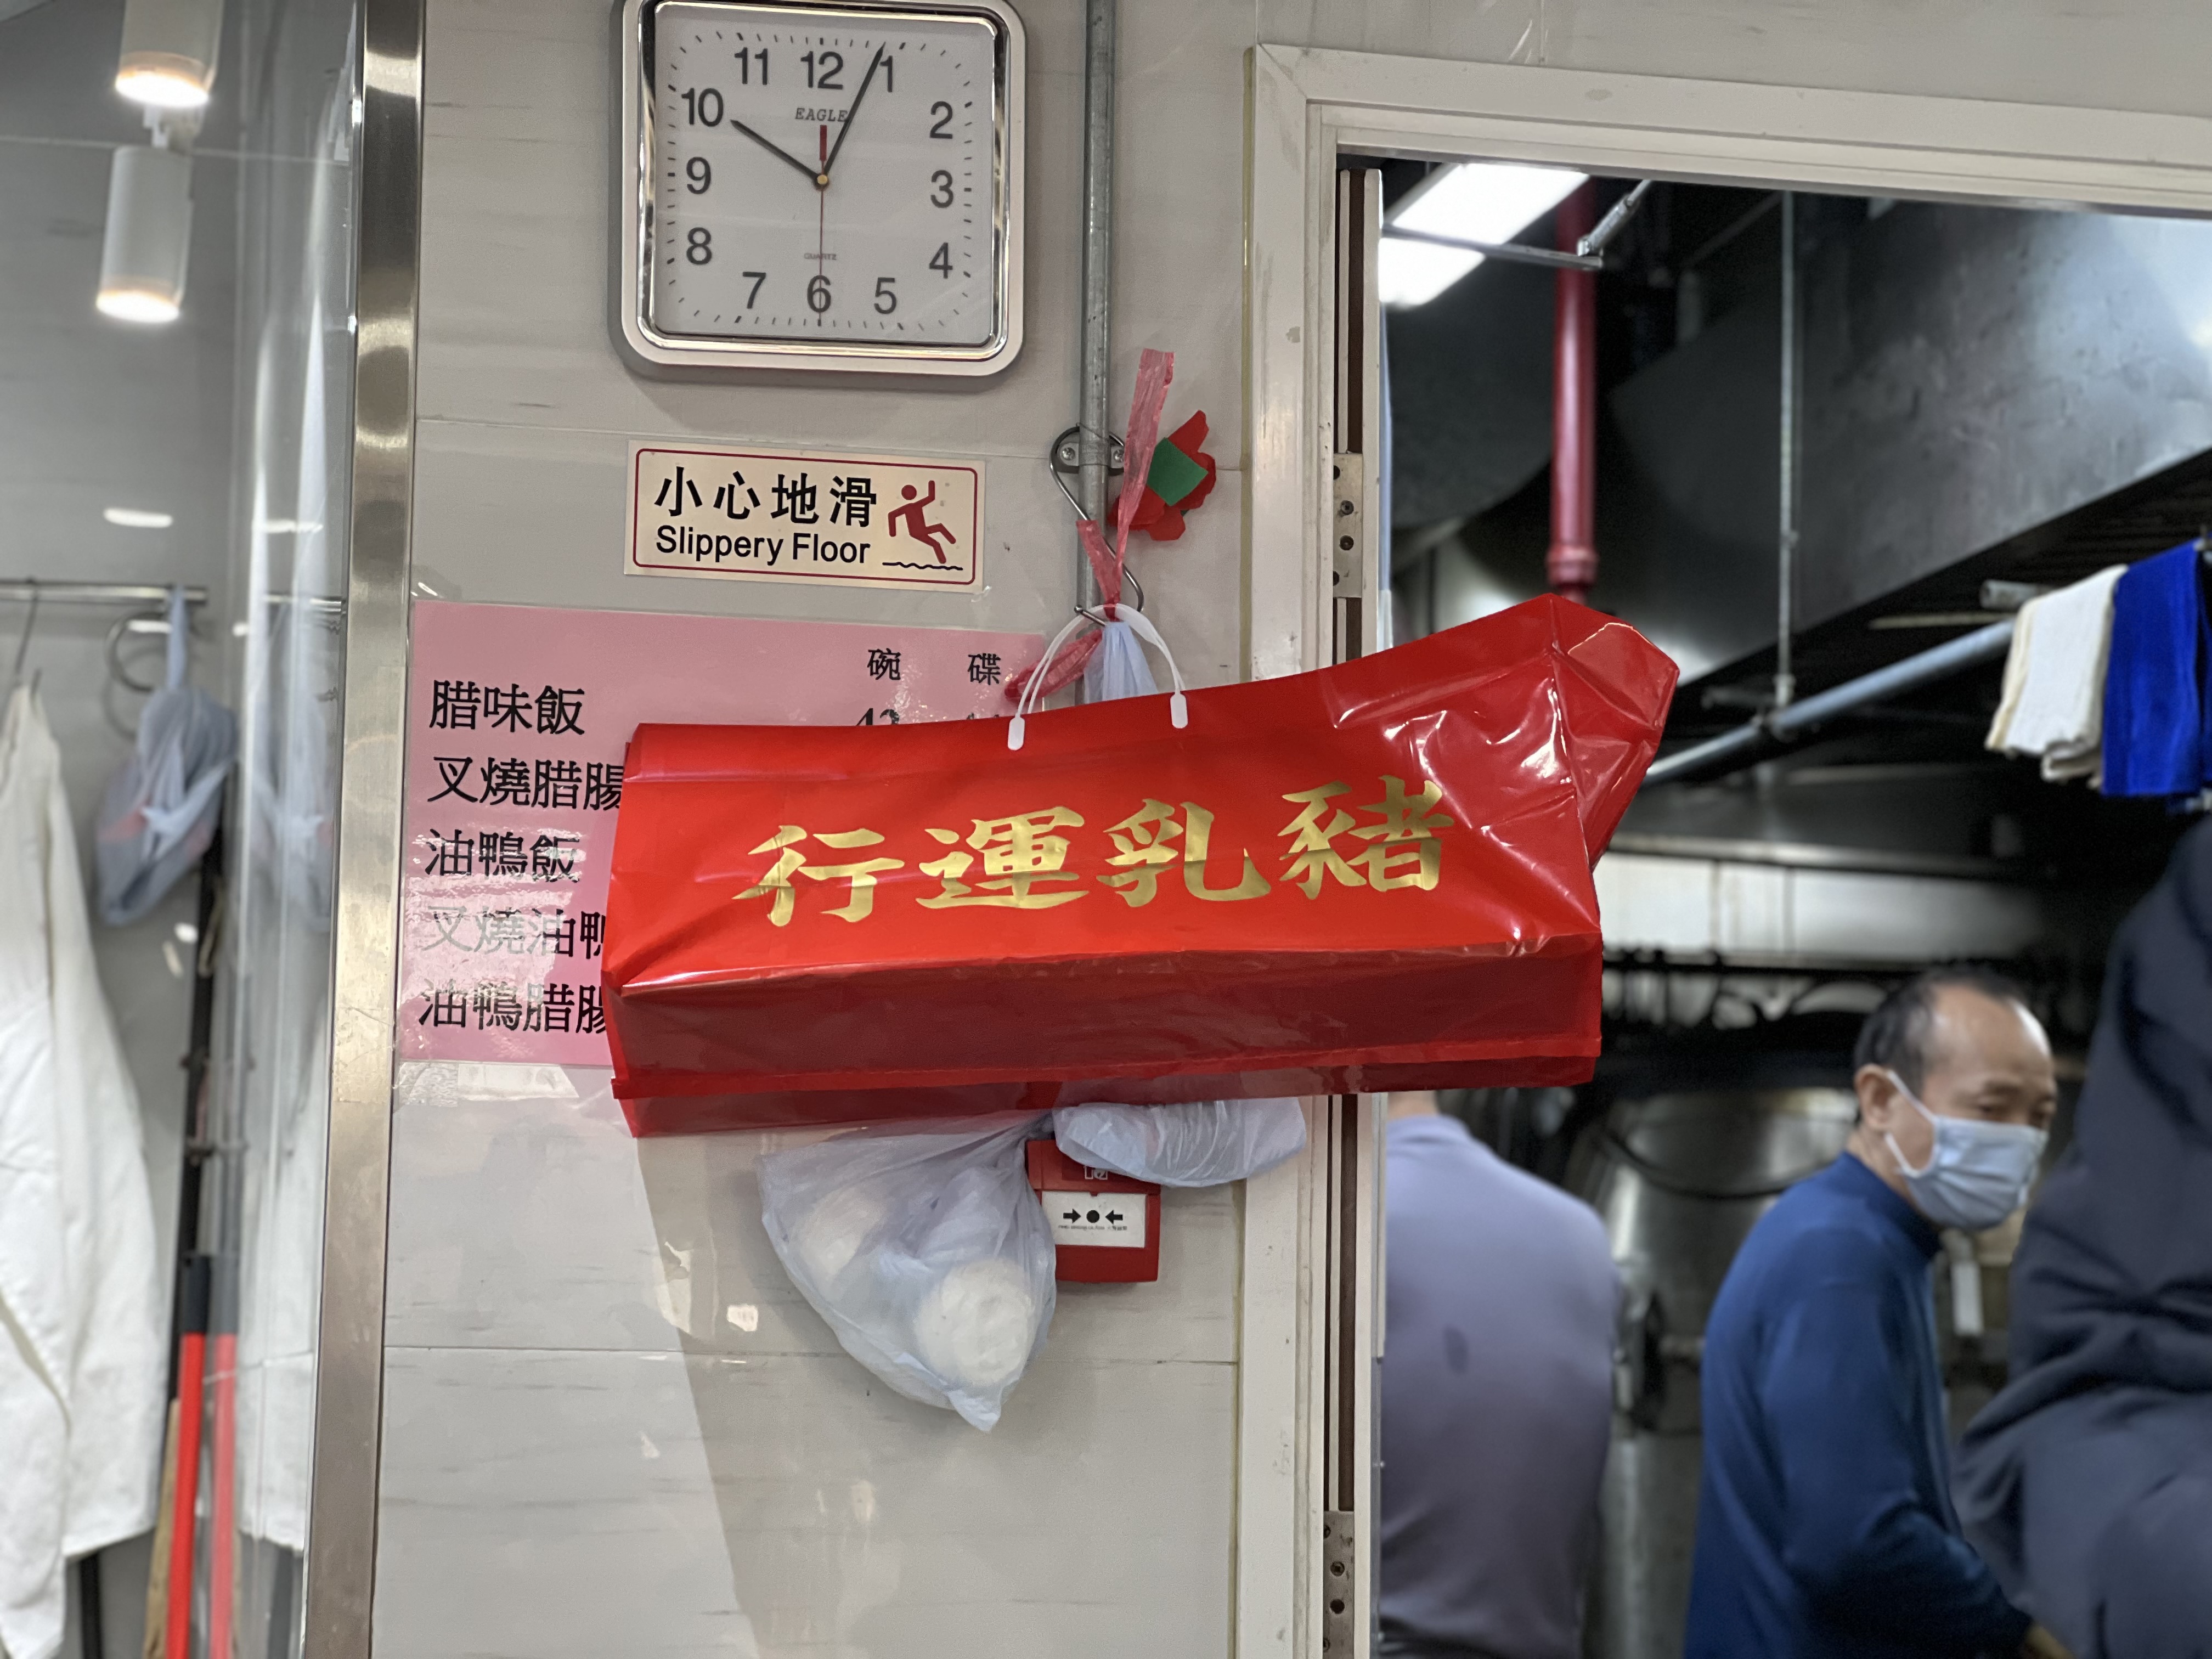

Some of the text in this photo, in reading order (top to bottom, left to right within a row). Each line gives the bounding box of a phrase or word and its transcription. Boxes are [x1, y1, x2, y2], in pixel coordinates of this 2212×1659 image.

[734, 47, 769, 85] 11
[800, 52, 843, 90] 12
[879, 56, 893, 93] 1
[681, 88, 724, 127] 10
[795, 108, 849, 122] EAGLE
[929, 101, 953, 139] 2
[686, 157, 712, 194] 9
[930, 171, 954, 208] 3
[686, 227, 713, 265] 8
[804, 252, 837, 261] QUARTZ
[929, 242, 953, 278] 4
[742, 272, 766, 309] 7
[806, 275, 832, 313] 6
[873, 278, 898, 314] 5
[654, 466, 877, 527] 小心地滑
[656, 525, 871, 566] Slippery Floor
[867, 648, 1001, 686] 碗 碟
[429, 680, 585, 735] 腊味飯
[427, 757, 624, 811] 叉燒腊腸
[425, 828, 582, 883] 油鴨飯
[731, 775, 1455, 927] 行運乳豬
